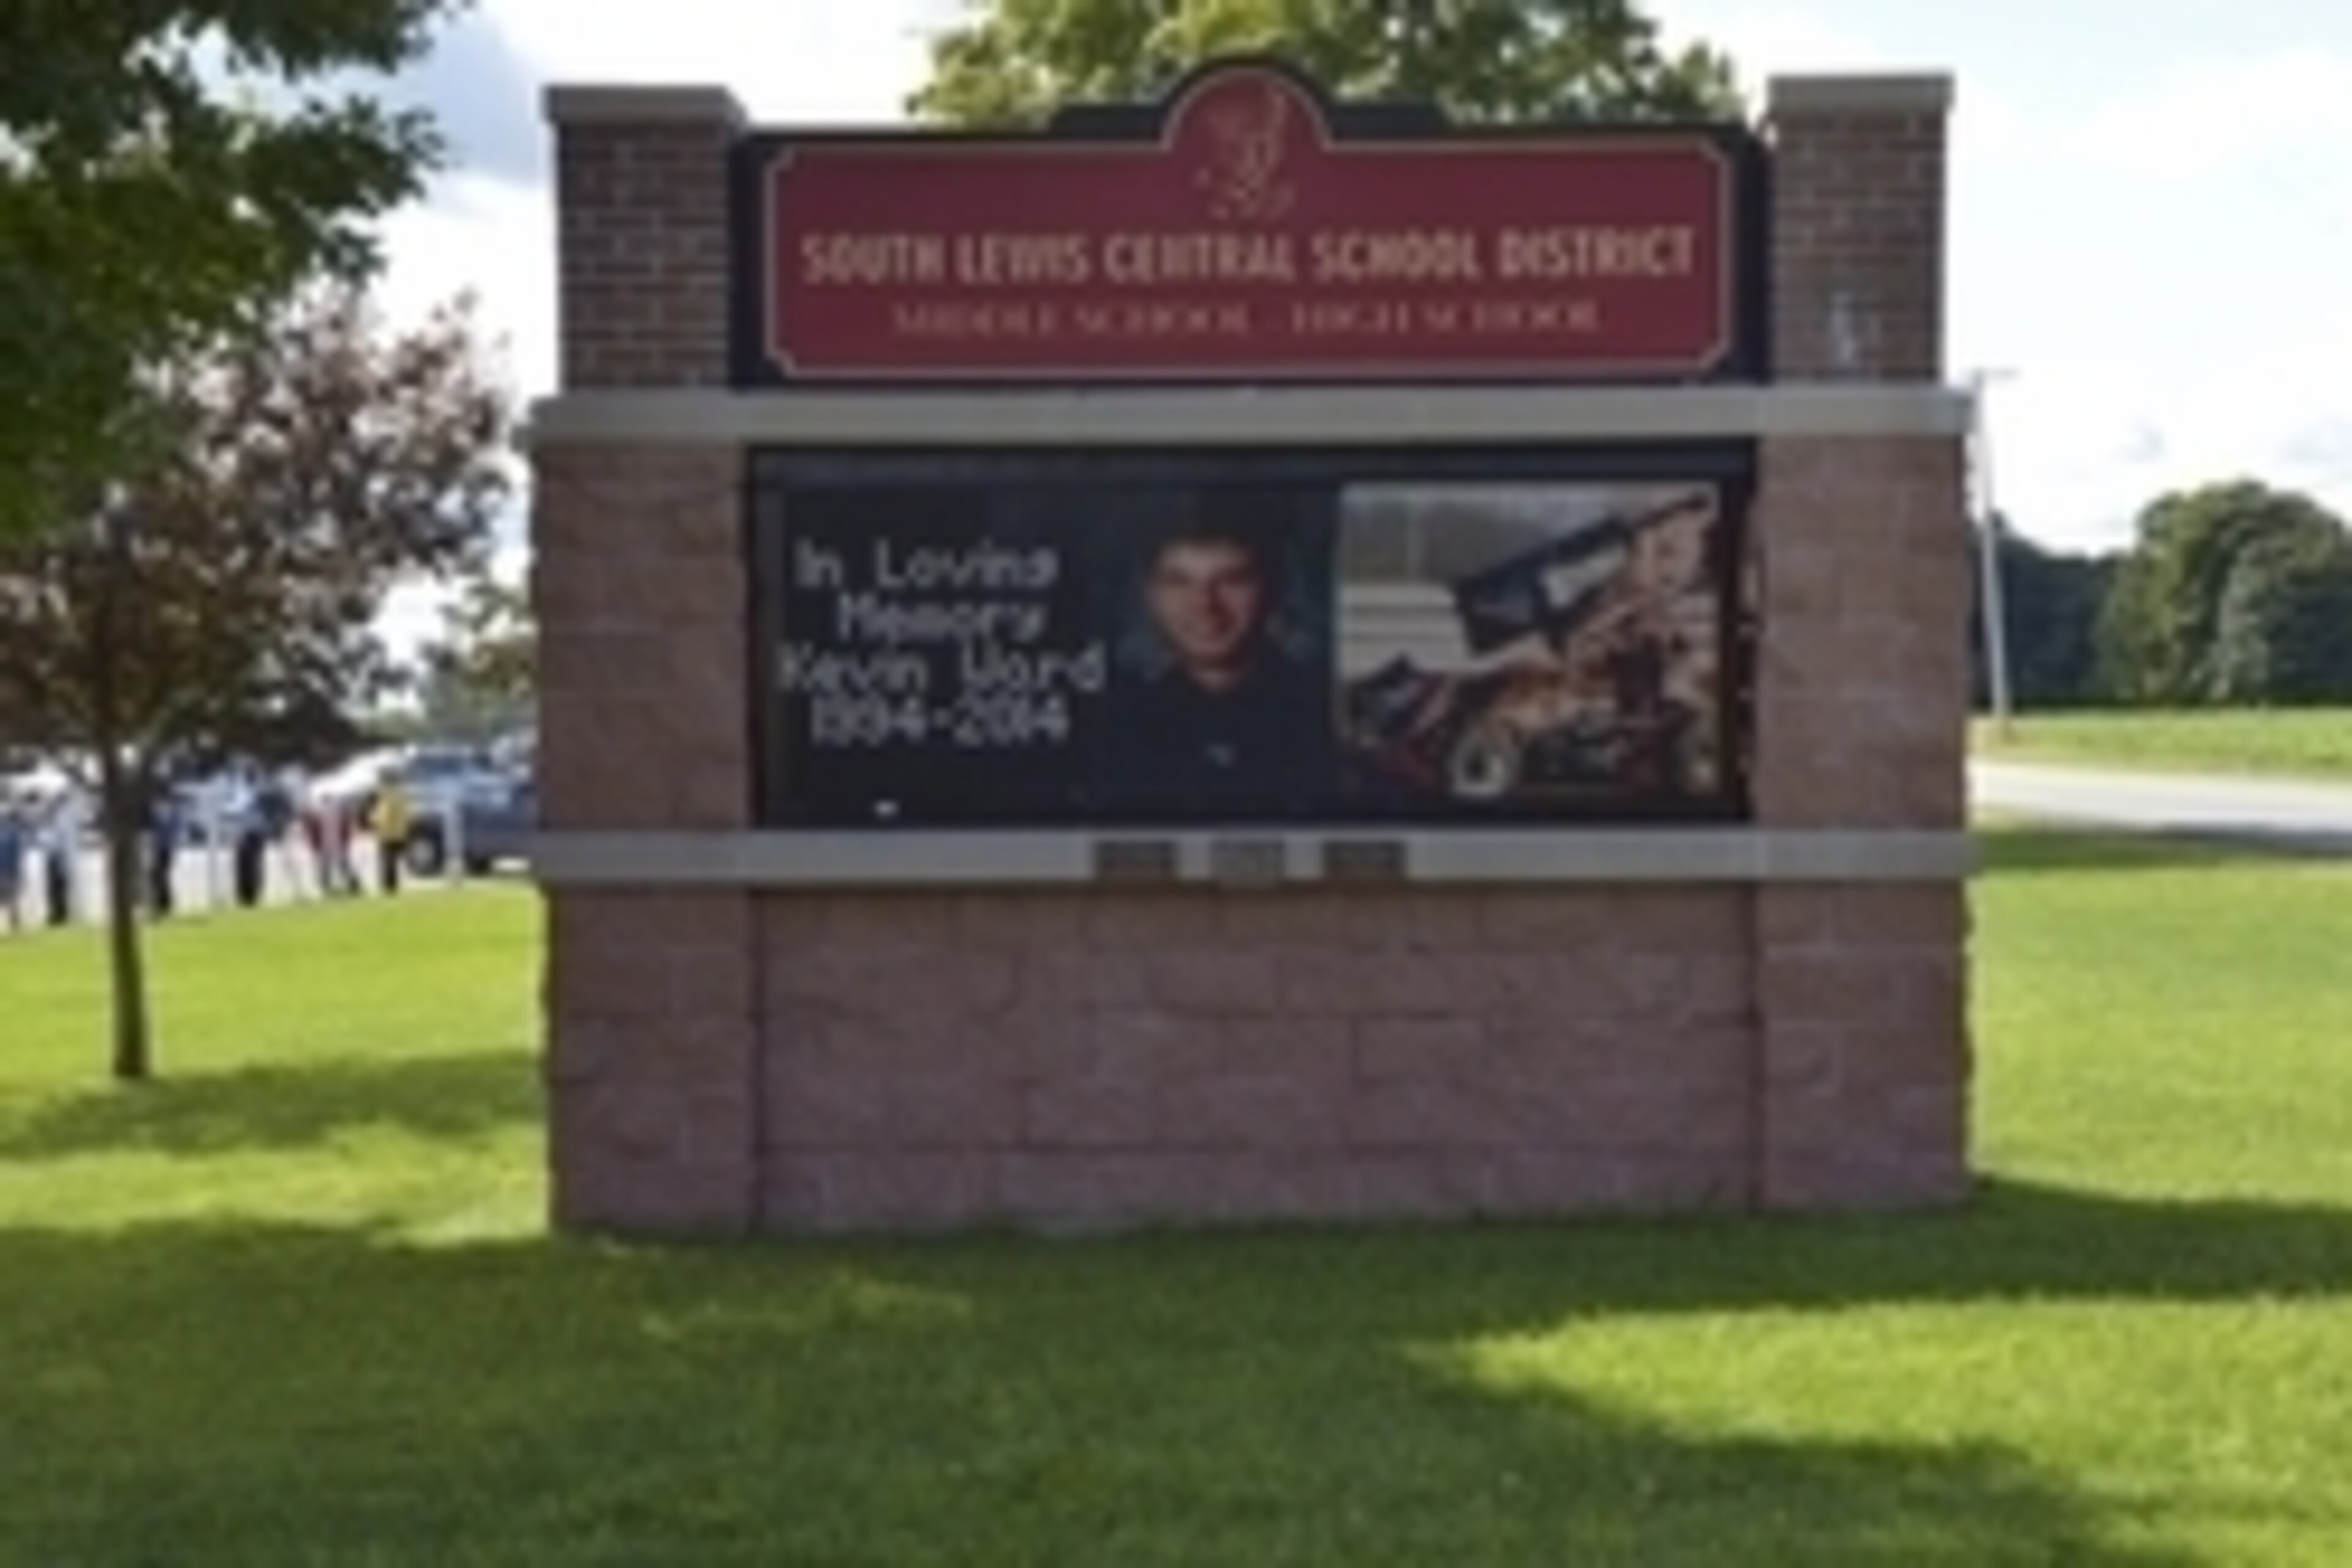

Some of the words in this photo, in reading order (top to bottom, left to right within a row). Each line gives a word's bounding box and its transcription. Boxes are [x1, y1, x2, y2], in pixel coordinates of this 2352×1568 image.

[800, 232, 947, 285] SOUTH
[954, 232, 1090, 285] LEWIS
[1103, 230, 1295, 284] CENTRAL
[1310, 227, 1481, 284] SCHOOL
[1498, 224, 1695, 280] DISTRICT
[797, 537, 843, 589] In
[875, 537, 1061, 589] Loving
[838, 592, 1045, 643] Memory
[777, 641, 929, 693] Kevin
[960, 638, 1106, 693] Ward
[810, 692, 1069, 746] 1994-2014
